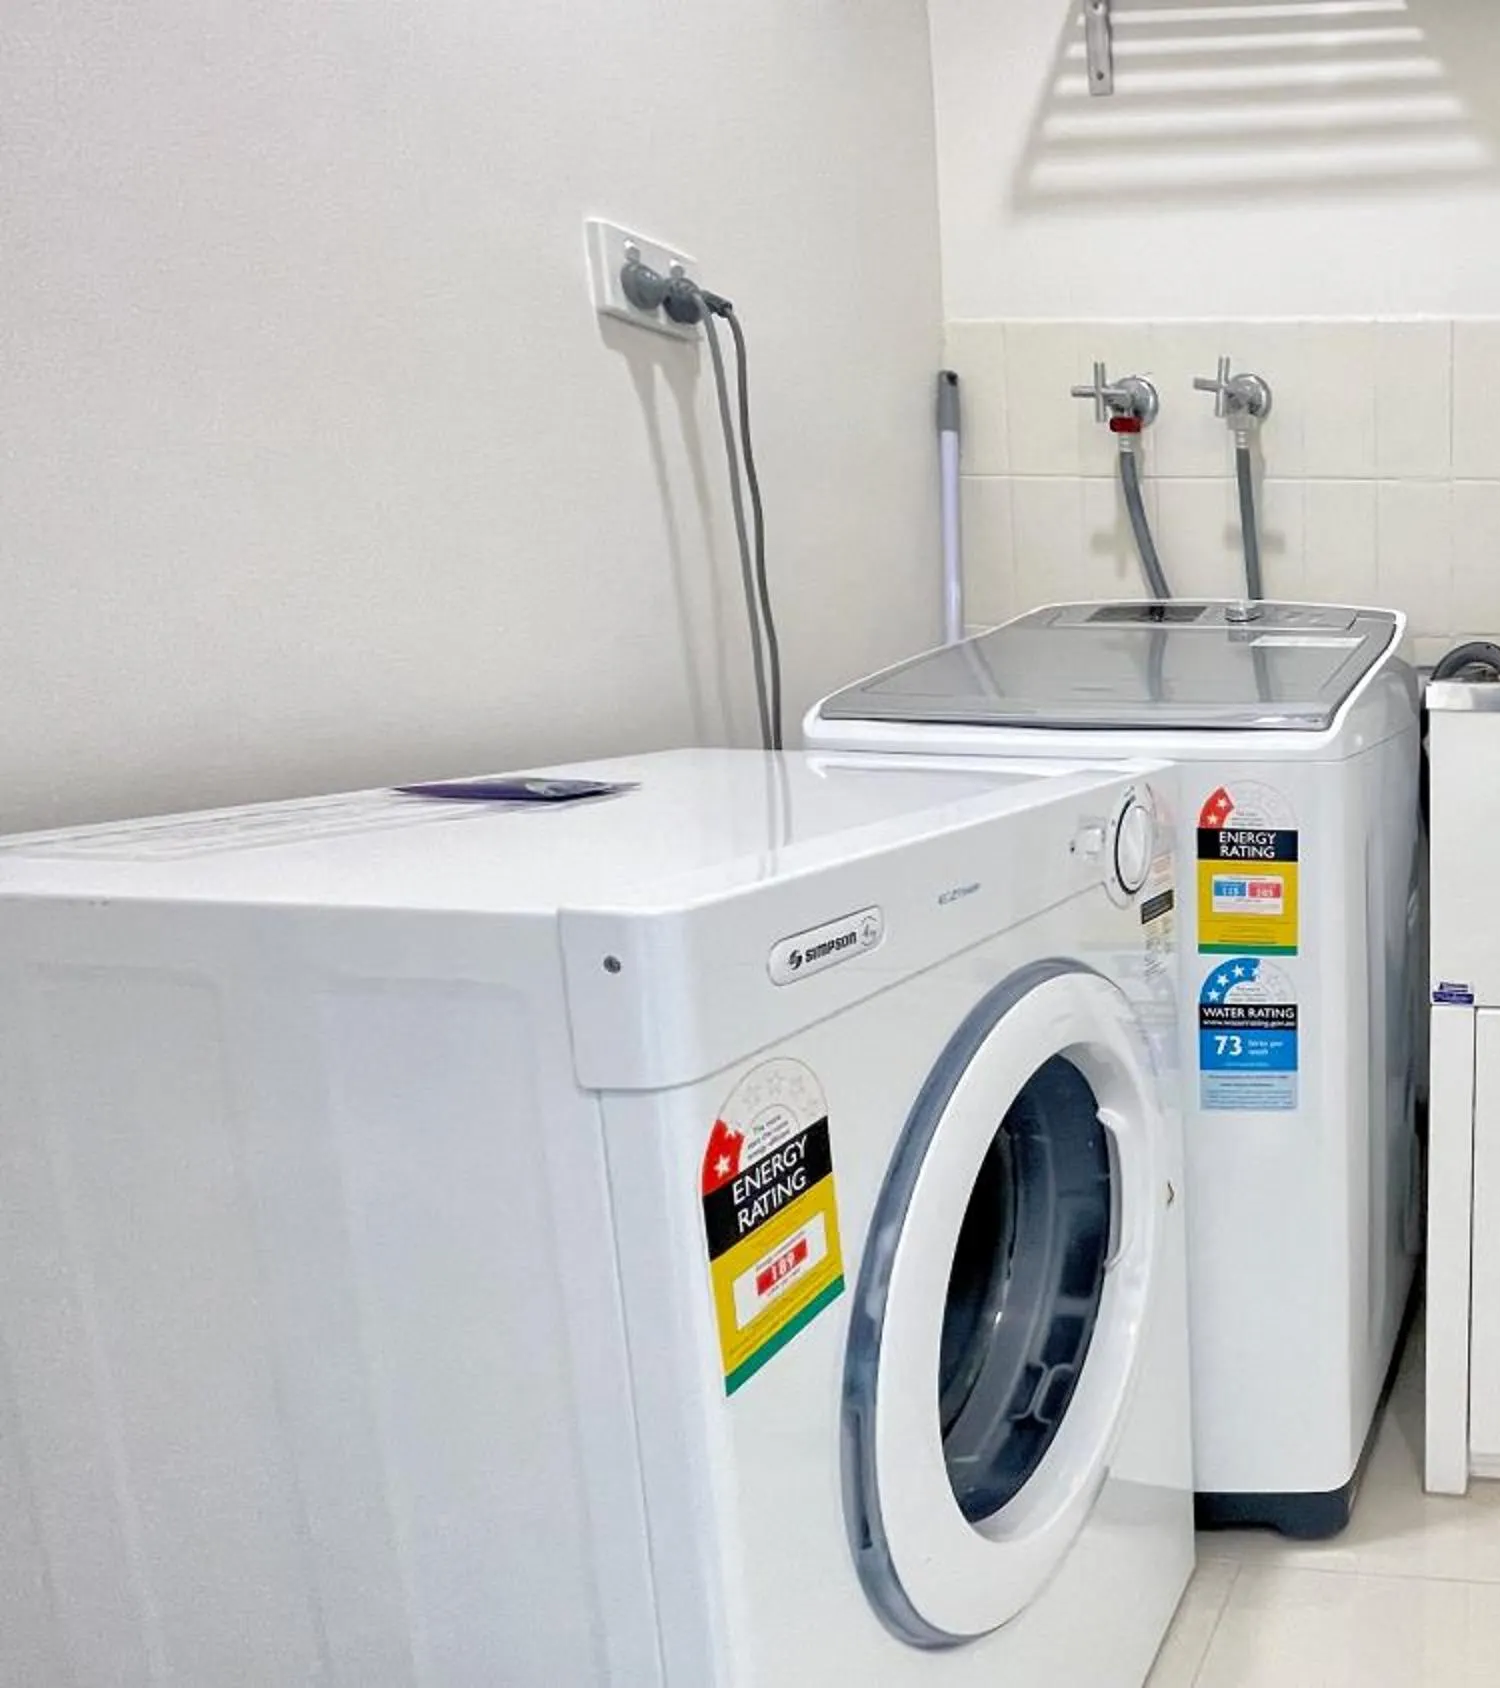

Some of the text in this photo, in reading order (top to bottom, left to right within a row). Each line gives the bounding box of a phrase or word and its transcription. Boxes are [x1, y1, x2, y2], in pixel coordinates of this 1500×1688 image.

[1219, 831, 1276, 844] ENERGY
[1220, 846, 1275, 859] RATING
[805, 931, 857, 963] SIMPSON
[1203, 1008, 1295, 1019] WATER RATING
[1214, 1035, 1243, 1056] 73
[732, 1134, 809, 1206] ENERGY
[737, 1167, 807, 1234] RATING
